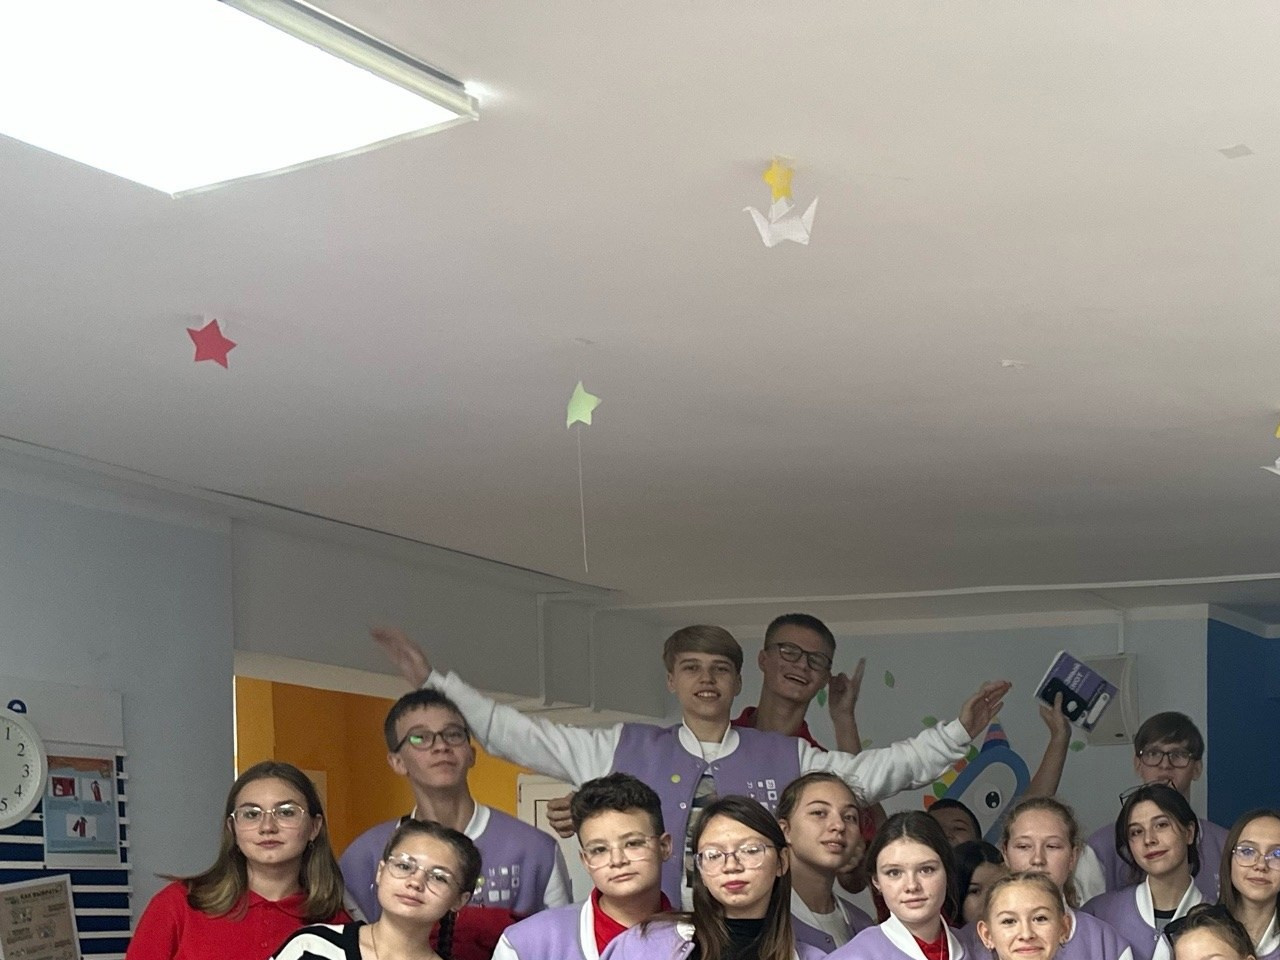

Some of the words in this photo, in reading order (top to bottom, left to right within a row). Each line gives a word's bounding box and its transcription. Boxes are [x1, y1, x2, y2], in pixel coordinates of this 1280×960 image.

[6, 726, 10, 740] 1
[17, 743, 25, 757] 2
[22, 764, 30, 778] 3
[14, 785, 22, 797] 4
